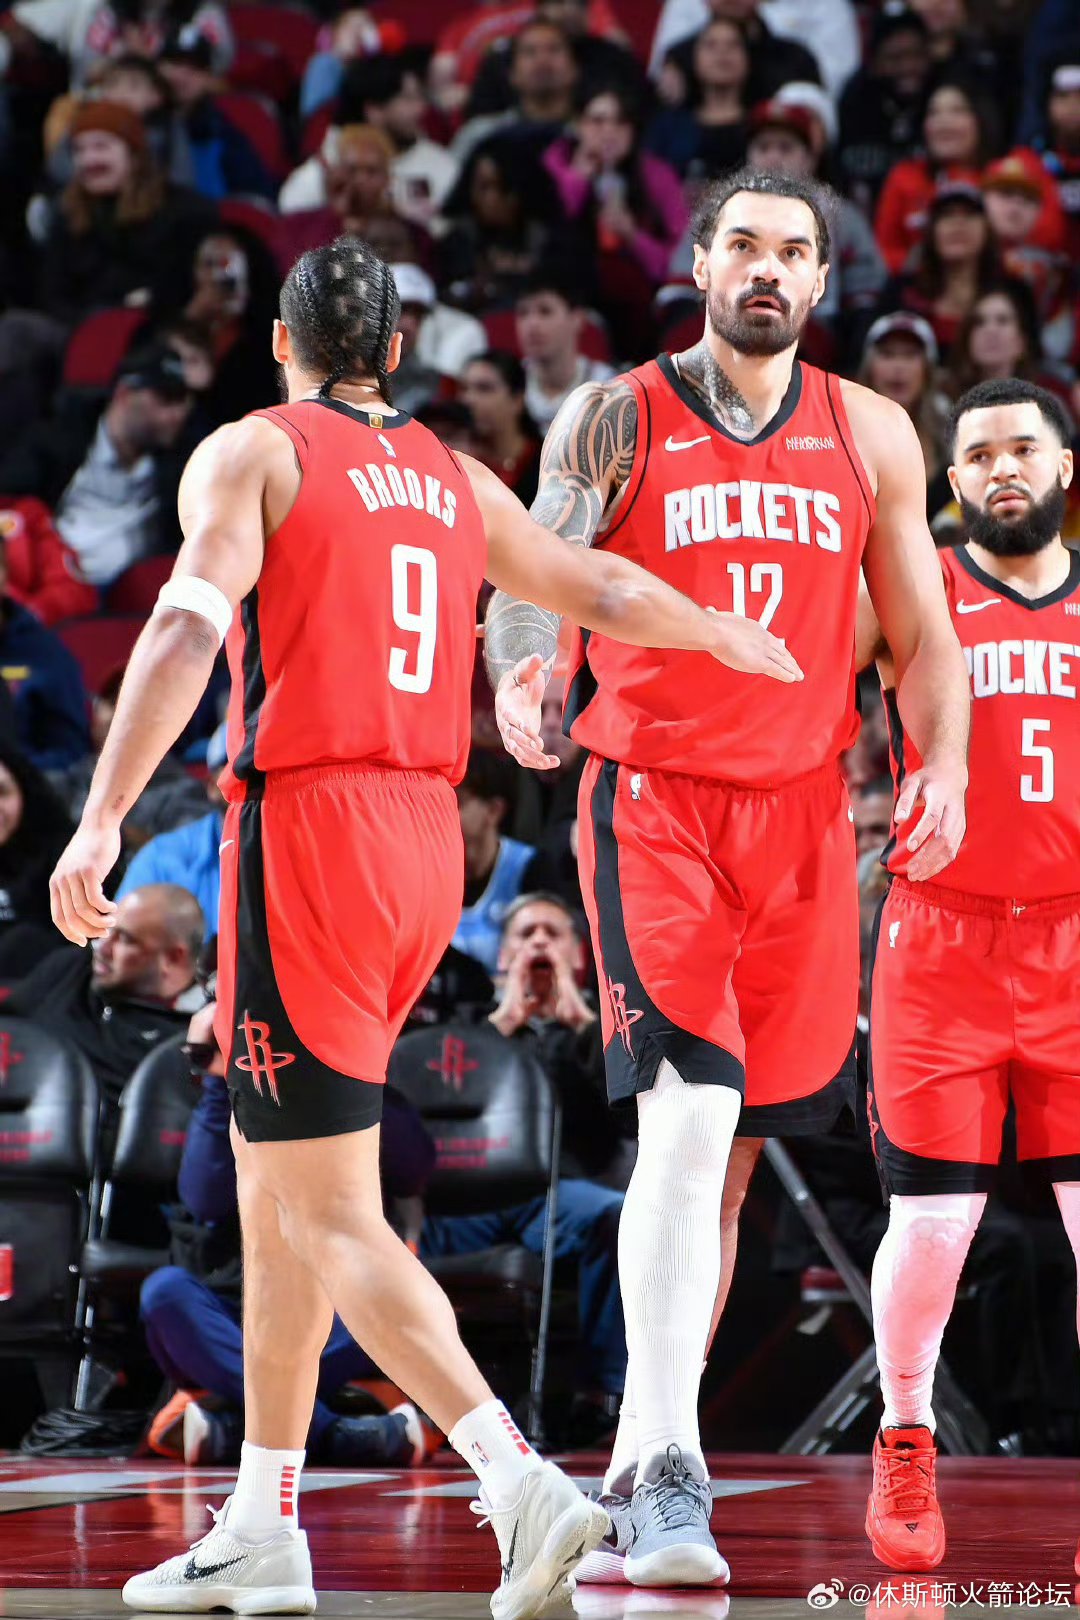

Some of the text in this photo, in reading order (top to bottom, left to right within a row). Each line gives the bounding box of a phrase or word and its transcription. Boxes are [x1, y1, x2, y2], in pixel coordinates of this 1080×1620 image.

[346, 463, 457, 528] BROOKS
[664, 480, 841, 552] ROCKETS
[388, 543, 437, 694] 9
[727, 562, 784, 648] 12
[963, 639, 1080, 700] OCKE
[1020, 718, 1054, 803] 5
